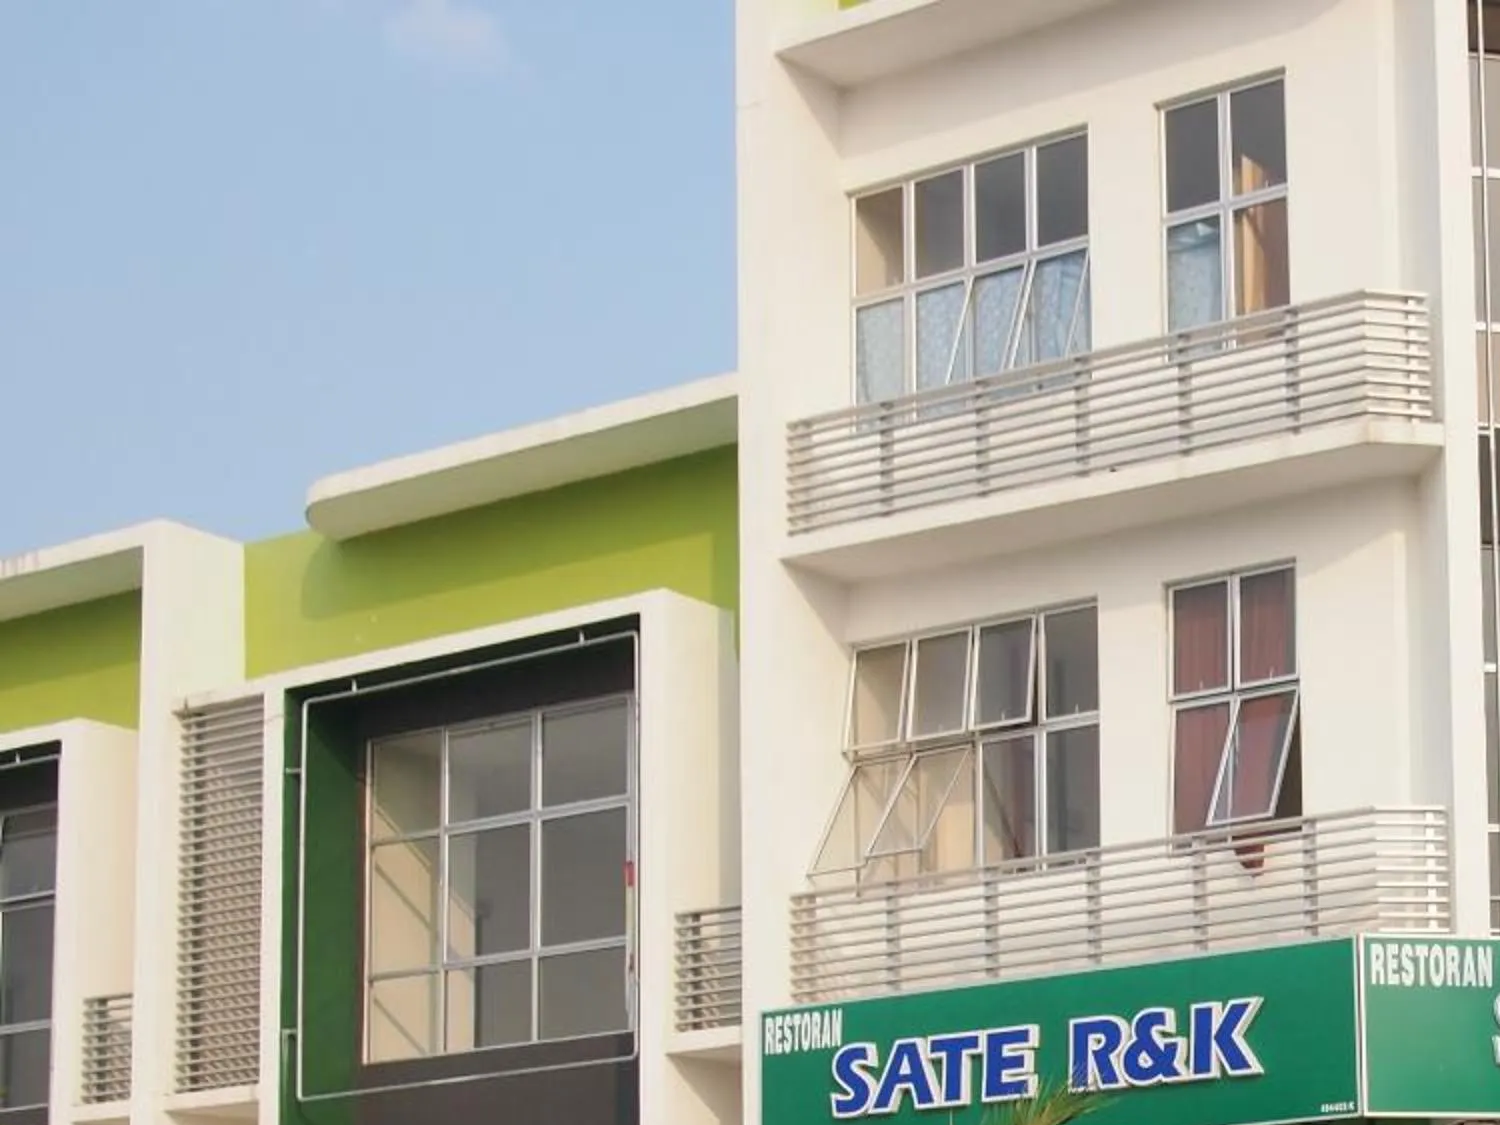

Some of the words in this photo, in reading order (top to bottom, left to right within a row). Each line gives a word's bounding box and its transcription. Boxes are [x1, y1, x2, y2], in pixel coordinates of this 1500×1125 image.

[1369, 943, 1493, 988] RESTORAN
[764, 1008, 843, 1055] RESTORAN
[831, 1023, 1039, 1120] SATE
[1068, 996, 1264, 1094] R&K
